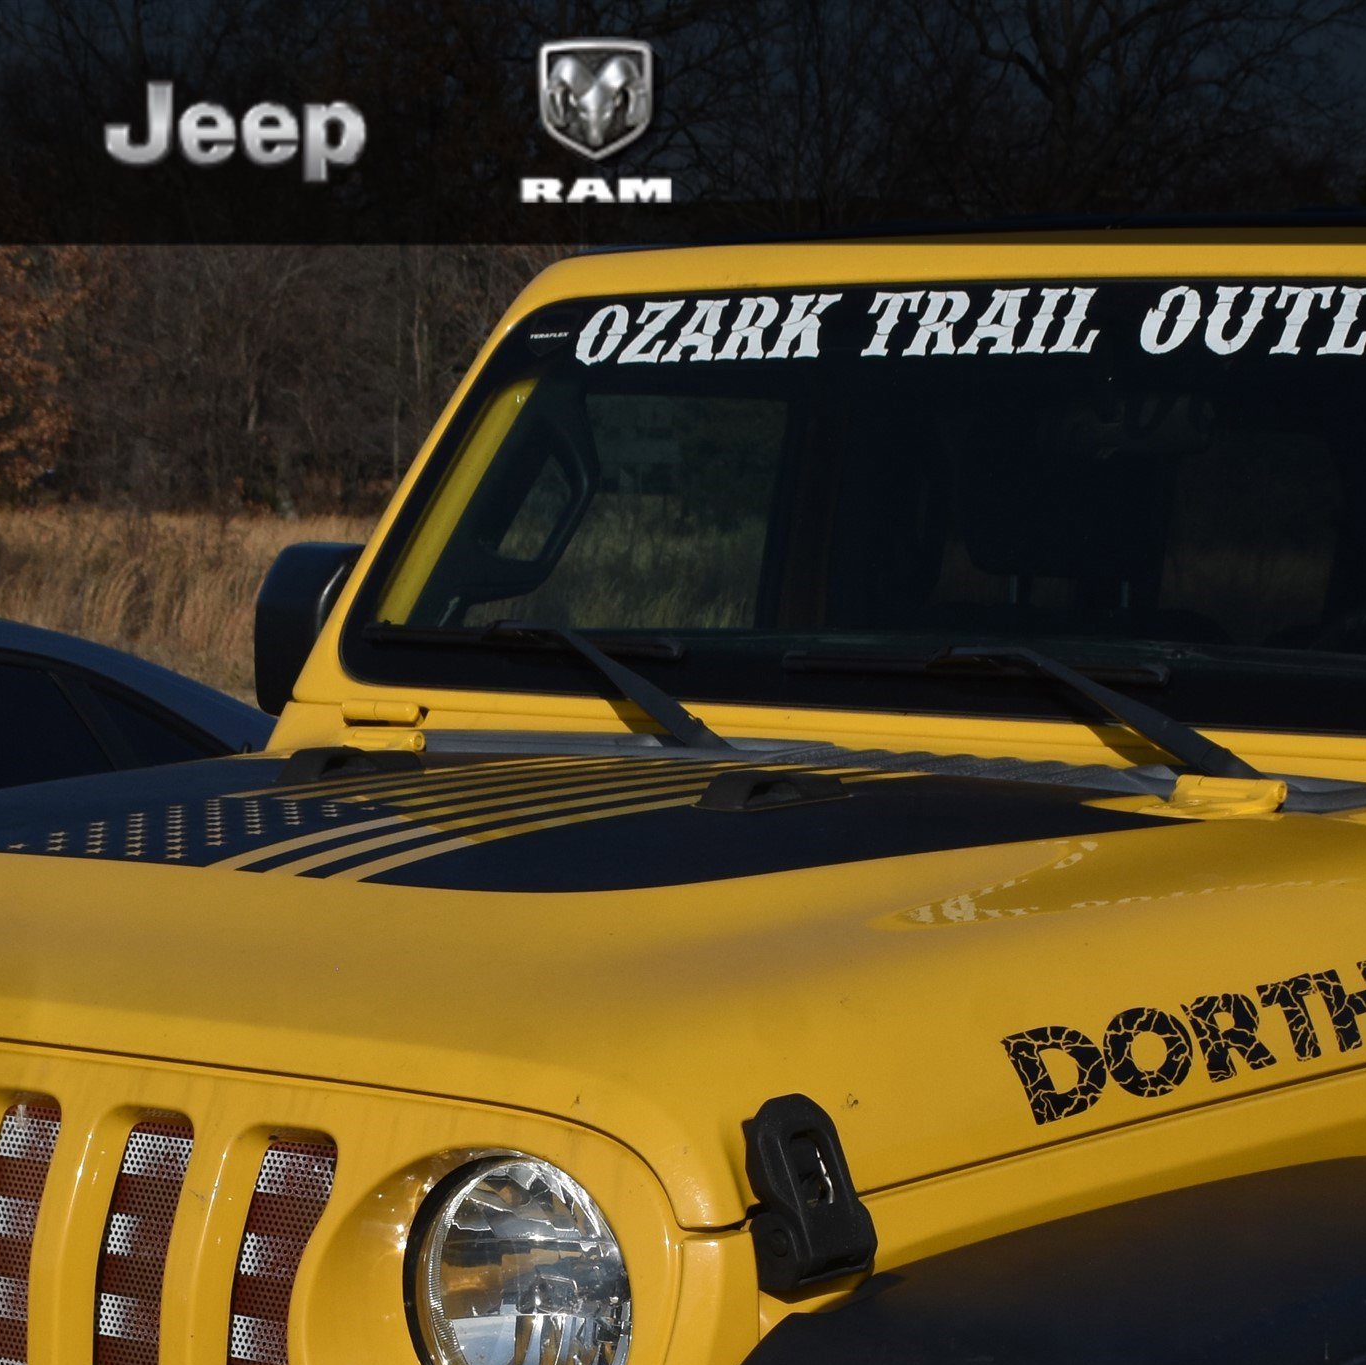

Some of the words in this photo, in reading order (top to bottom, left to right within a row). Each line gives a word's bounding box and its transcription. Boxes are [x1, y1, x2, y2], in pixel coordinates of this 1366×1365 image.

[529, 331, 569, 340] TERAFLEX
[575, 293, 842, 366] OZARK
[860, 286, 1100, 357] TRAIL
